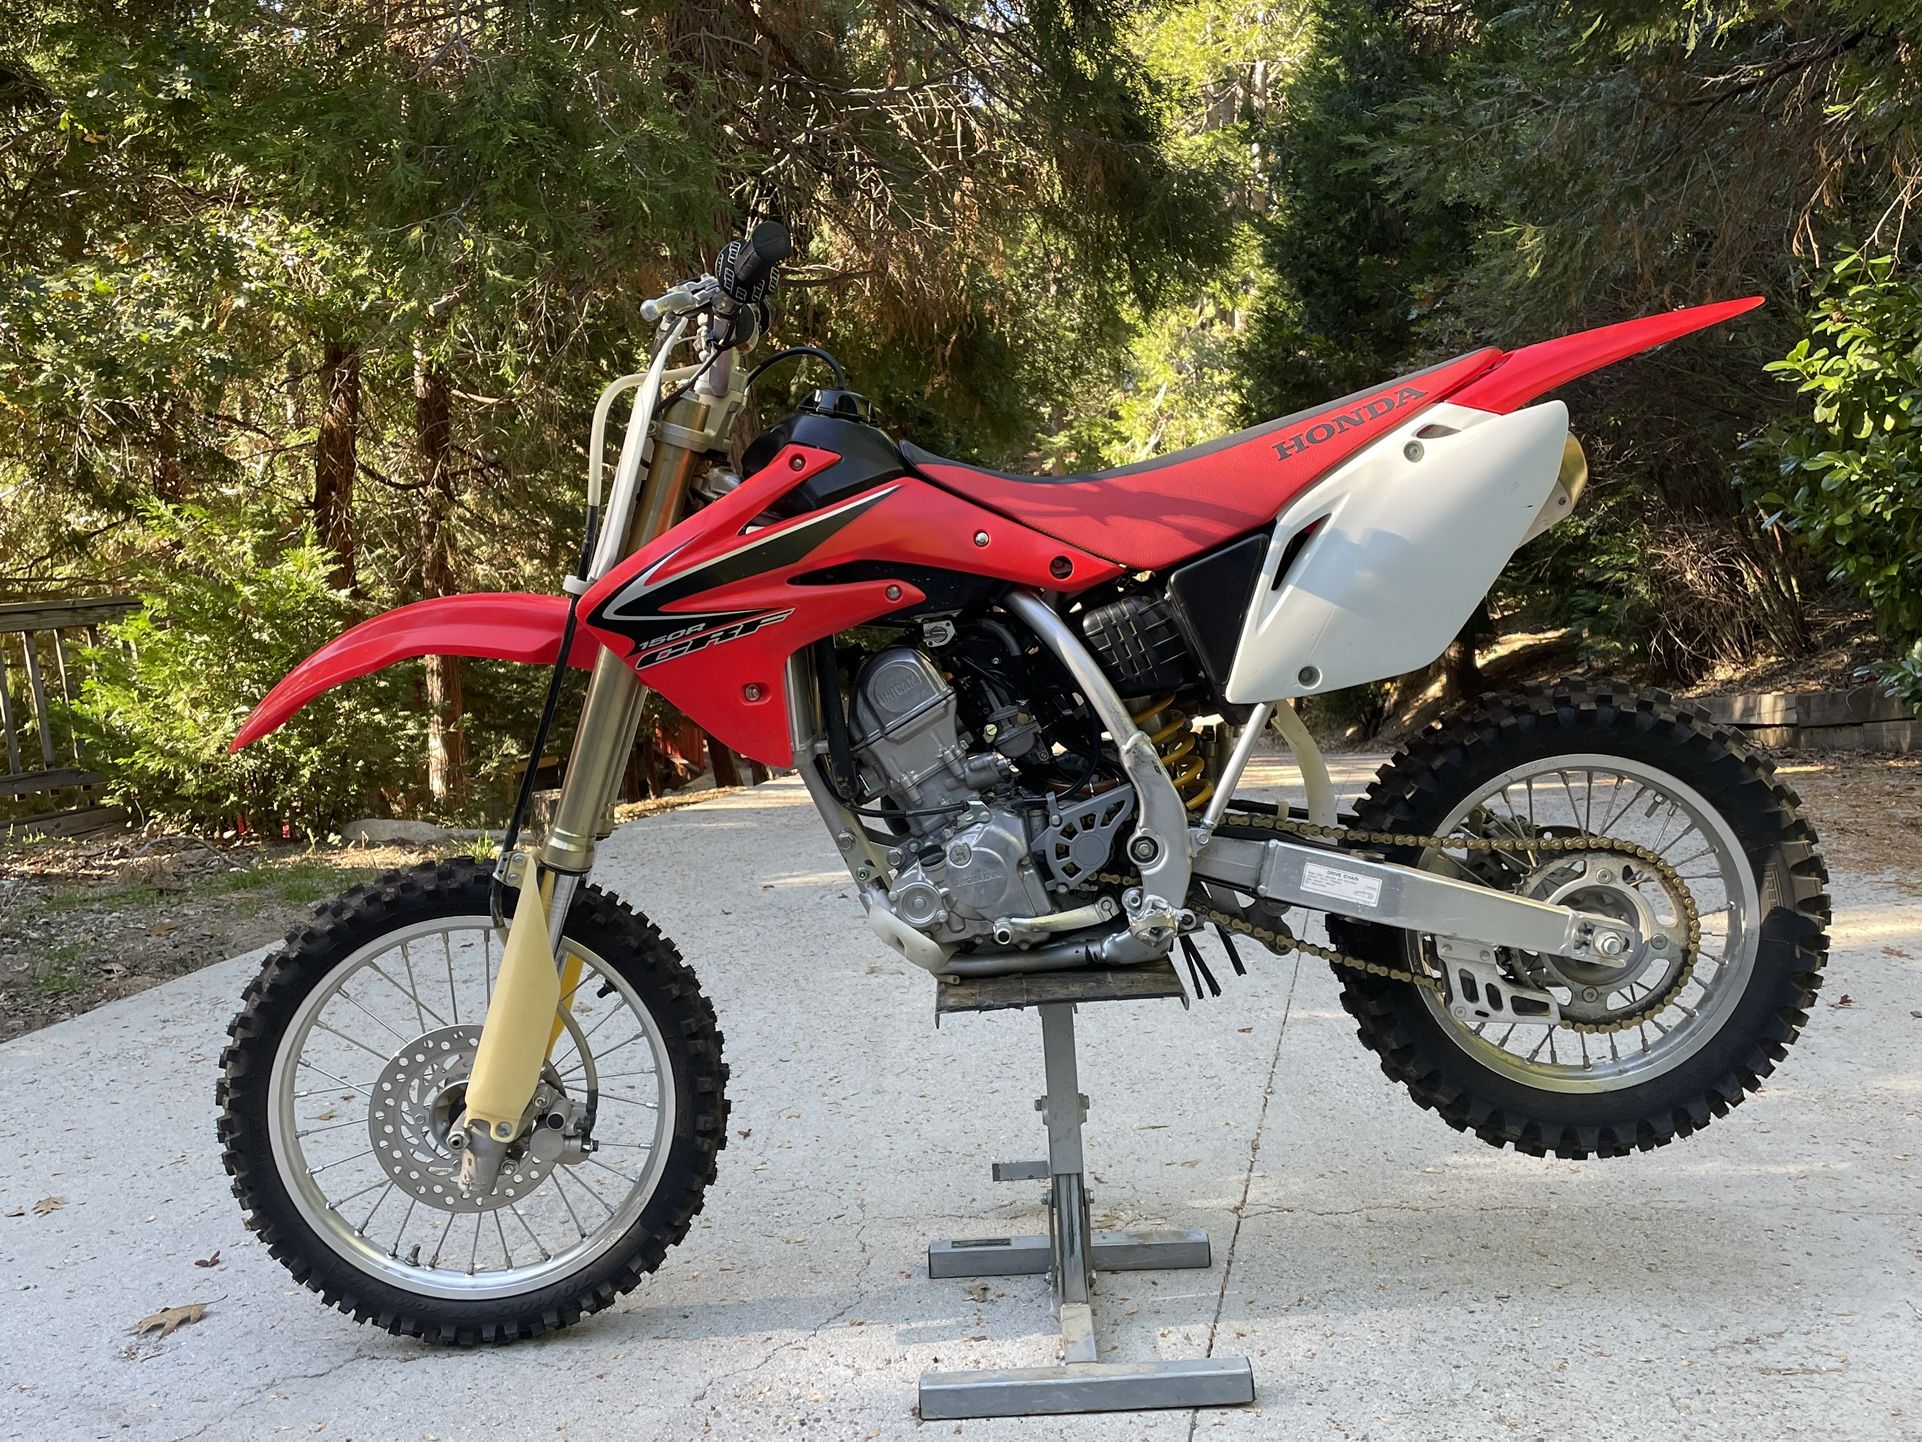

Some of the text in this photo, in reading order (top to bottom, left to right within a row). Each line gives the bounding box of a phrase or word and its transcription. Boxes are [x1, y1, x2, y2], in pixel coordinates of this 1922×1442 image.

[1272, 385, 1429, 462] HONDA
[635, 607, 797, 671] CRF
[639, 622, 706, 650] 150R
[1326, 870, 1342, 878] DRIVE
[1343, 874, 1360, 882] CHAIN
